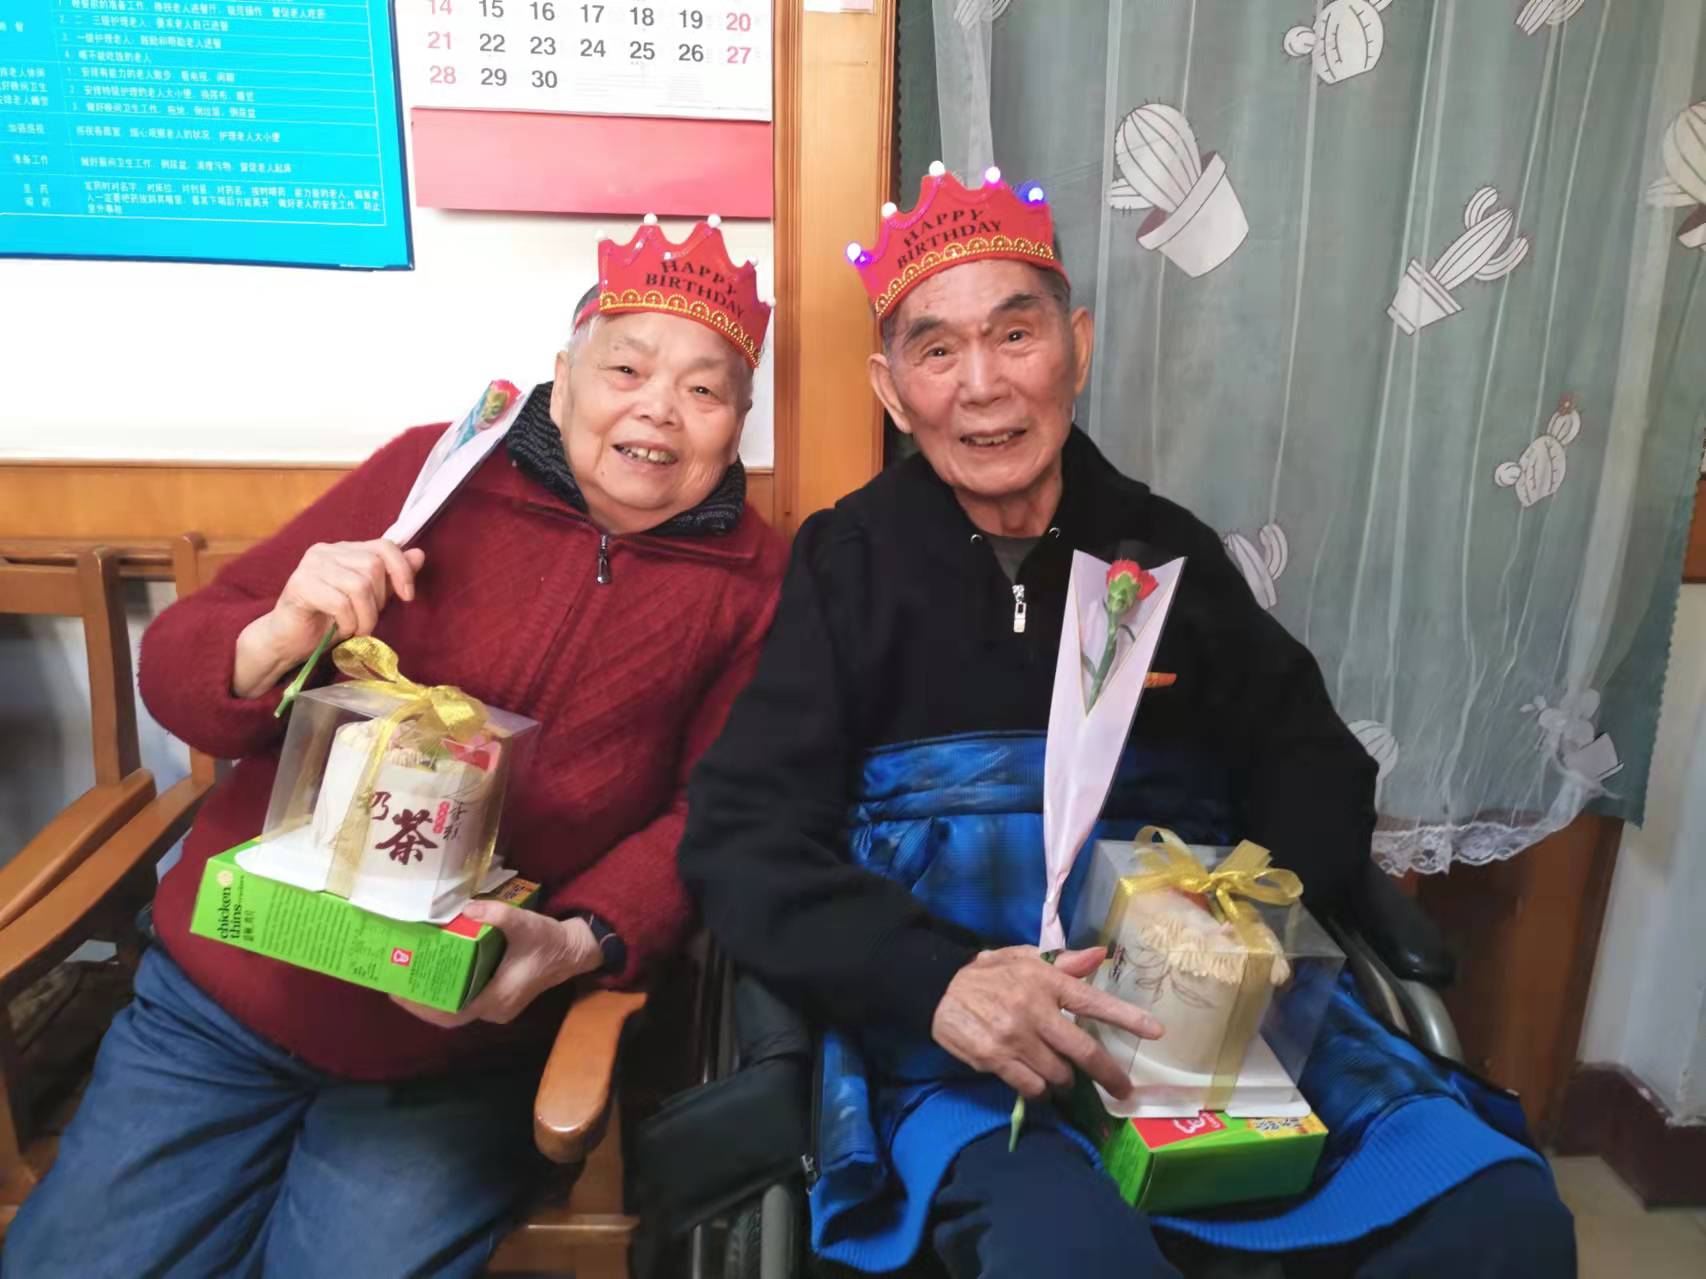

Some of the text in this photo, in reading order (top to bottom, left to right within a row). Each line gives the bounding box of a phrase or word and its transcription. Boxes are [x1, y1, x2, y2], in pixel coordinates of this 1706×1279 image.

[430, 0, 751, 32] 14 15 16 17 18 19 20
[427, 31, 751, 64] 21 22 23 24 25 26 27
[429, 65, 558, 88] 28 29 30
[897, 219, 1002, 268] BIRTHDAY
[903, 209, 984, 247] HAPPY
[646, 272, 745, 318] BIRTHDAY
[660, 259, 737, 296] HAPPY
[217, 887, 231, 939] chicken
[229, 904, 241, 938] thins
